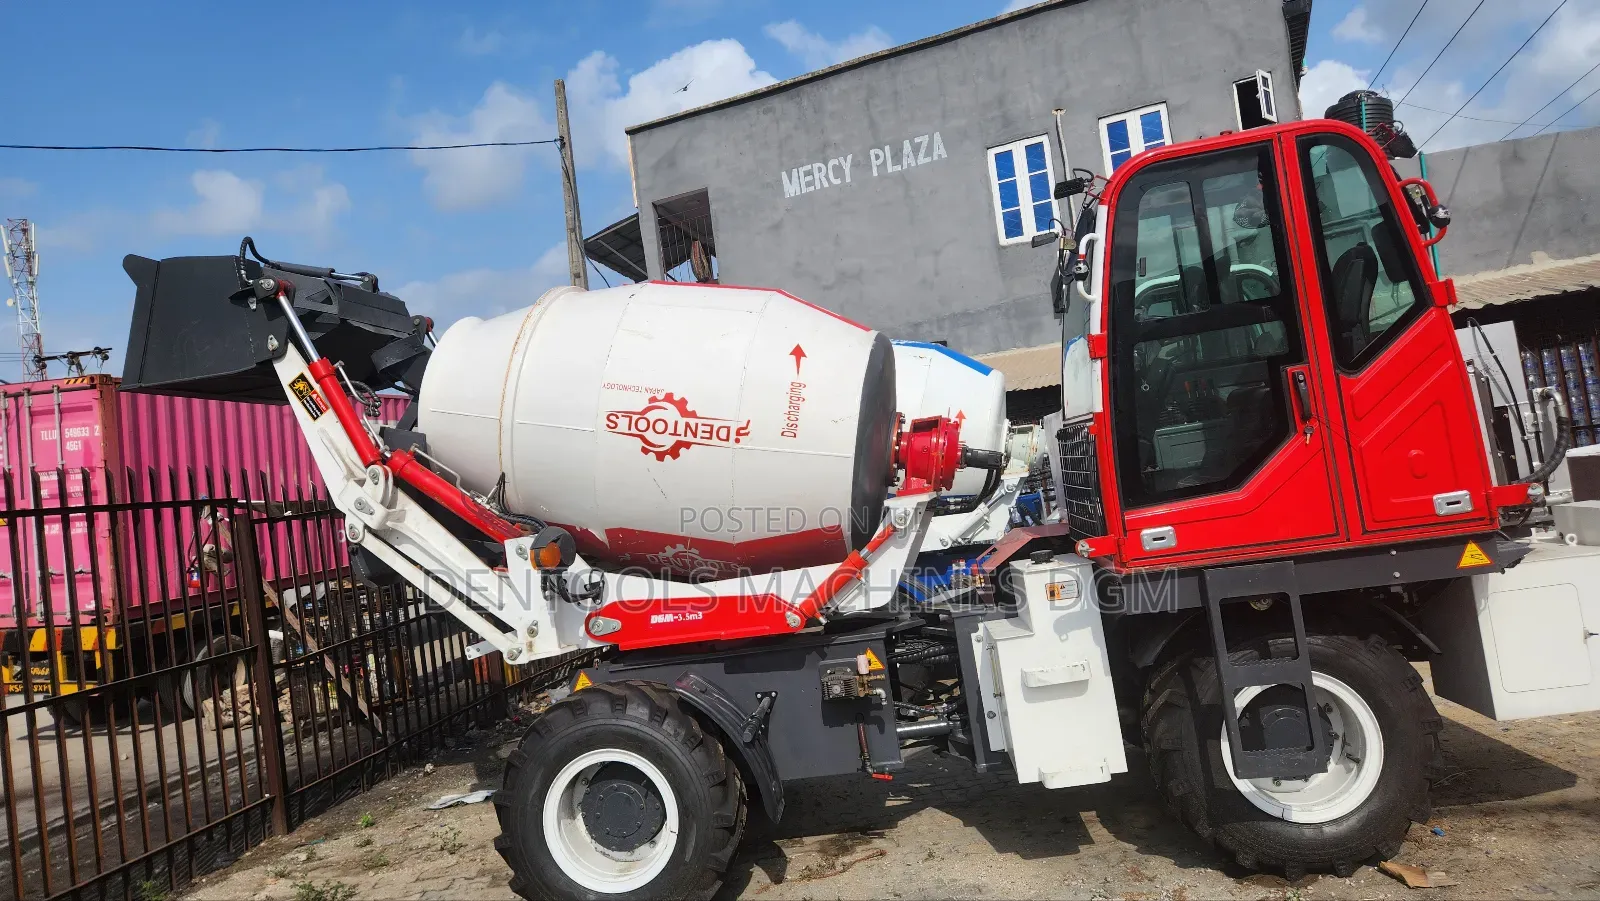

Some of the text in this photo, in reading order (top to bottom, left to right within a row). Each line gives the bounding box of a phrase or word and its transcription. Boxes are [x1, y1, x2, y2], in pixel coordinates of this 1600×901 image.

[781, 131, 948, 198] MERCY PLAZA
[602, 382, 665, 395] JAPAN TECHNOLOGY
[781, 381, 806, 438] Discharging
[40, 429, 57, 440] TLLU
[94, 425, 100, 436] 2
[605, 413, 731, 442] DENTOOLS
[646, 554, 742, 572] DENTOOLS
